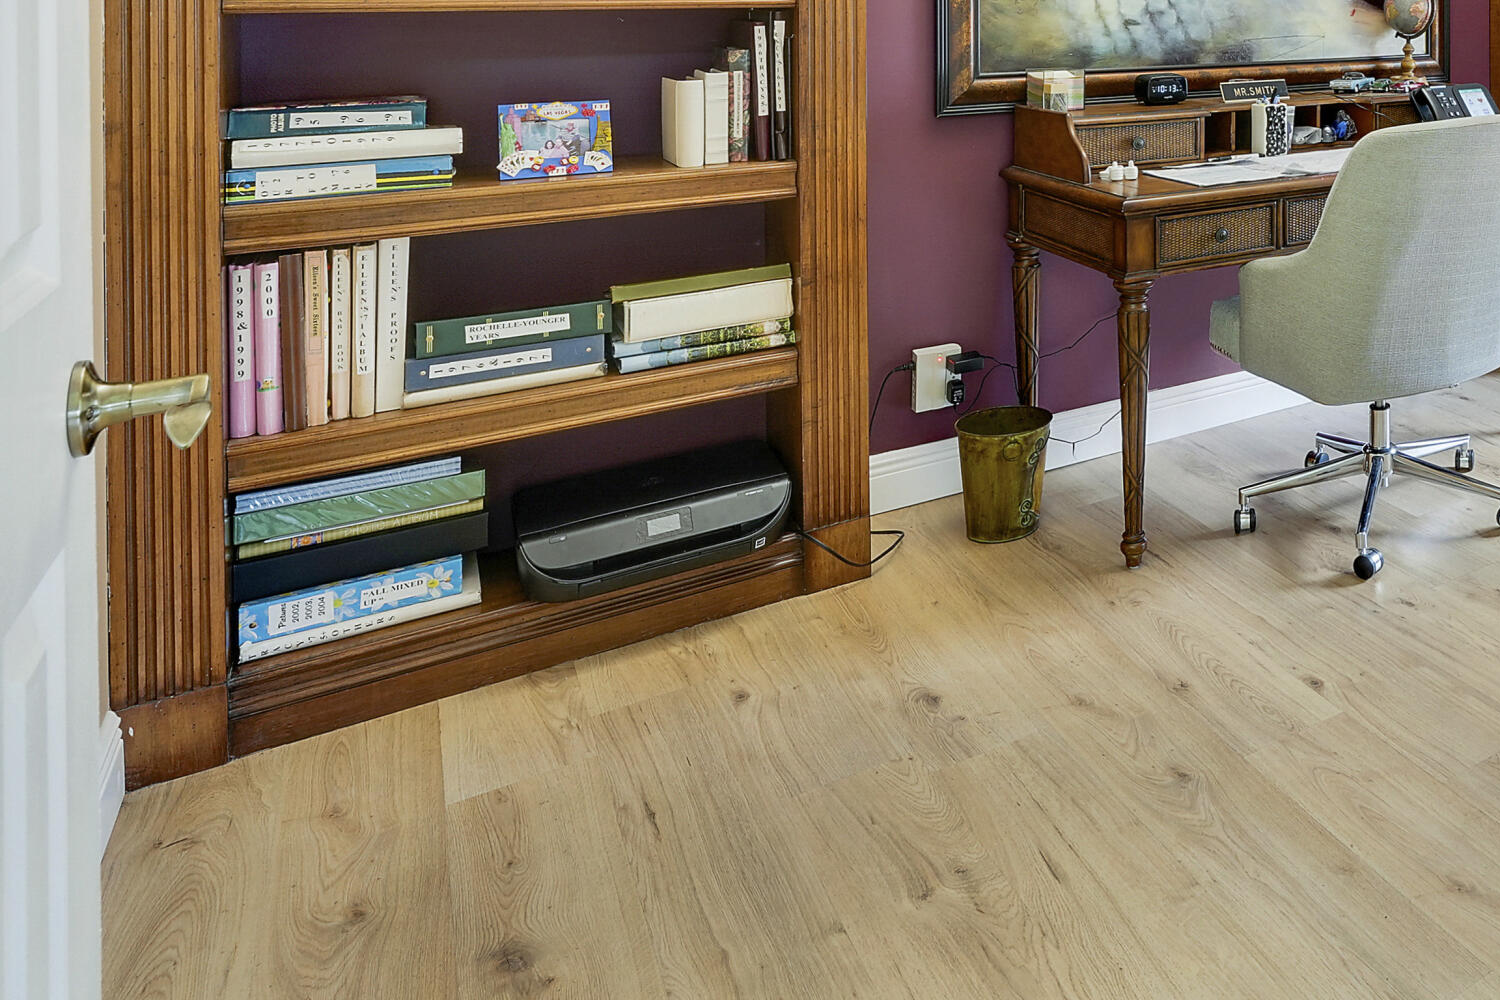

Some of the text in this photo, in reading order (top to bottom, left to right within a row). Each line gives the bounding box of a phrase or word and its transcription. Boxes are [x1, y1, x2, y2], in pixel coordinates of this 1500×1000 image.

[1157, 84, 1177, 93] 10:13
[265, 273, 274, 317] 2000
[312, 265, 320, 337] Eileen's Sweet Sixteen
[469, 315, 567, 333] ROCHELLE-YOUNGER
[389, 312, 399, 361] PROOFS
[468, 332, 500, 341] YEARS
[344, 509, 439, 537] PHOTO ALBUM
[391, 579, 424, 593] MIXED
[317, 596, 326, 616] 2004
